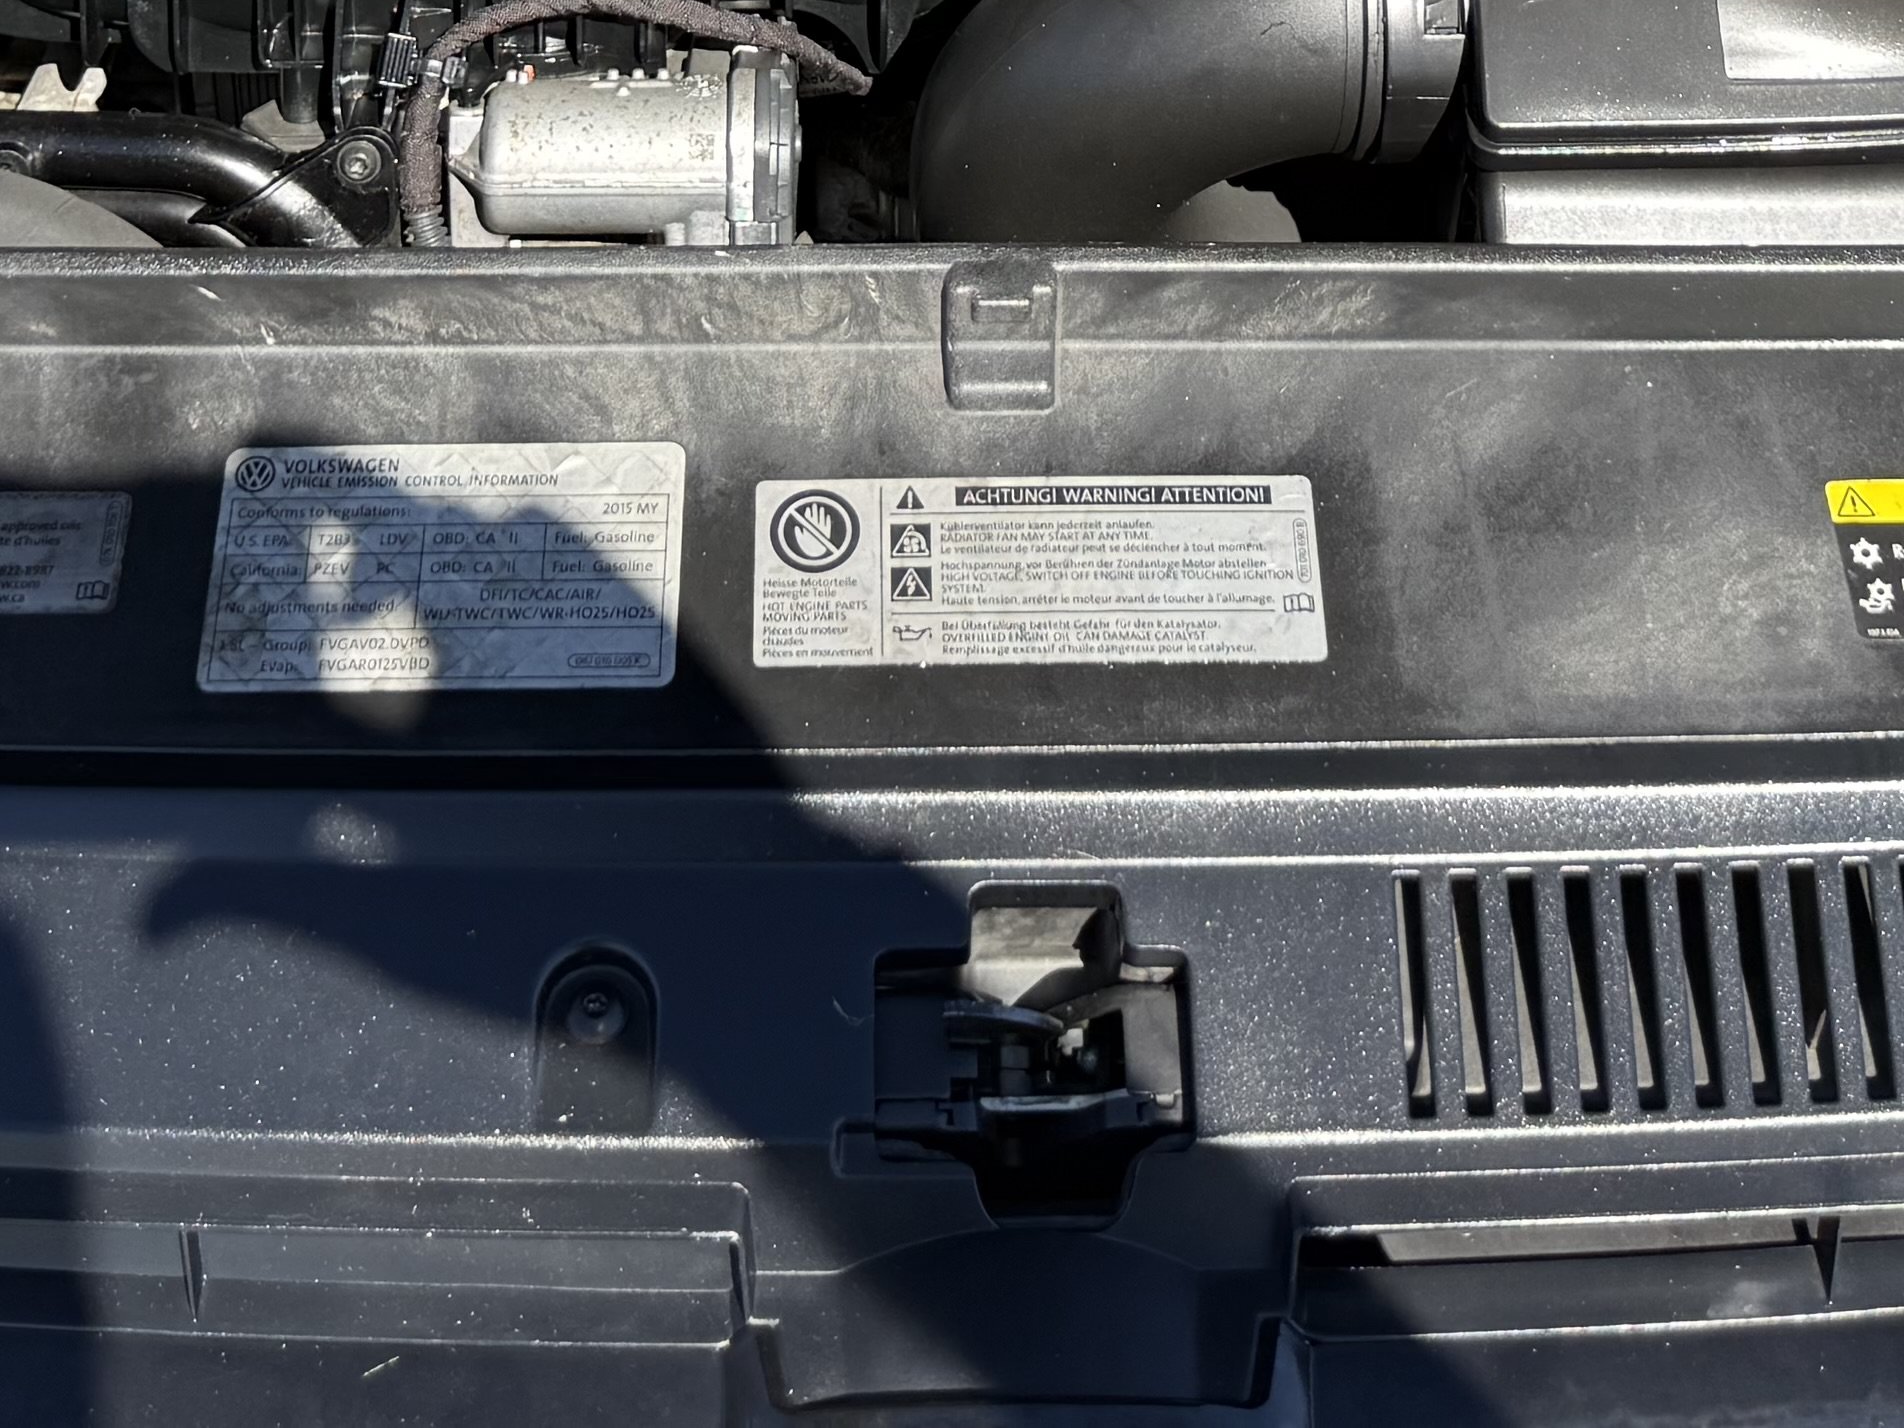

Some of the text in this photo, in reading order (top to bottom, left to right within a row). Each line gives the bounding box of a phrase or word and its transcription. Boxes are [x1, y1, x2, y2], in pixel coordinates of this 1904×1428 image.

[283, 458, 400, 474] VOLKSWAGEN
[282, 473, 559, 489] VEHICLE EMISSION CONTROL INFORMATION
[962, 485, 1265, 505] ACHTUNG! WARNING! ATTENTION!
[238, 506, 305, 519] Conforms
[310, 506, 324, 518] to
[602, 503, 633, 515] 2015
[636, 502, 659, 514] MY
[1028, 521, 1054, 530] kann
[380, 533, 409, 545] LDV
[475, 530, 496, 543] CA
[594, 531, 655, 543] Gasoline
[940, 533, 993, 542] RADIATOR
[997, 533, 1018, 542] FAN
[1021, 532, 1045, 541] MAY
[1048, 532, 1080, 541] START
[1082, 532, 1095, 540] AT
[1098, 532, 1121, 540] ANY
[940, 544, 951, 554] Le
[954, 543, 1012, 554] ventilateur
[1015, 544, 1027, 553] de
[1031, 543, 1079, 553] radiateur
[1082, 543, 1106, 555] peut
[1192, 543, 1214, 552] tout
[314, 562, 352, 575] PZEV
[376, 562, 394, 574] PC
[473, 561, 493, 573] CA
[593, 559, 654, 573] Gasoline
[1097, 559, 1113, 569] der
[1182, 559, 1216, 568] Motor
[941, 570, 1294, 582] HIGH SWITCH OFF ENGINE BEFORE TOUCHING IGNITION
[762, 577, 857, 588] Heisse Motorteile
[763, 587, 837, 600] Bewegte Teile
[762, 600, 868, 611] HOT ENGINE PARTS
[941, 595, 974, 606] Haute
[1073, 595, 1112, 604] moteur
[1115, 594, 1145, 604] avant
[1148, 595, 1160, 603] de
[1164, 594, 1204, 603] toucher
[762, 612, 846, 622] MOVING PARTS
[1133, 618, 1154, 629] den
[795, 626, 848, 635] du moteur
[942, 631, 1150, 643] OVERFILLED ENGINE OIL CAN DAMAGE
[796, 649, 808, 657] en
[811, 646, 873, 657] mouvement
[1158, 644, 1183, 655] pour
